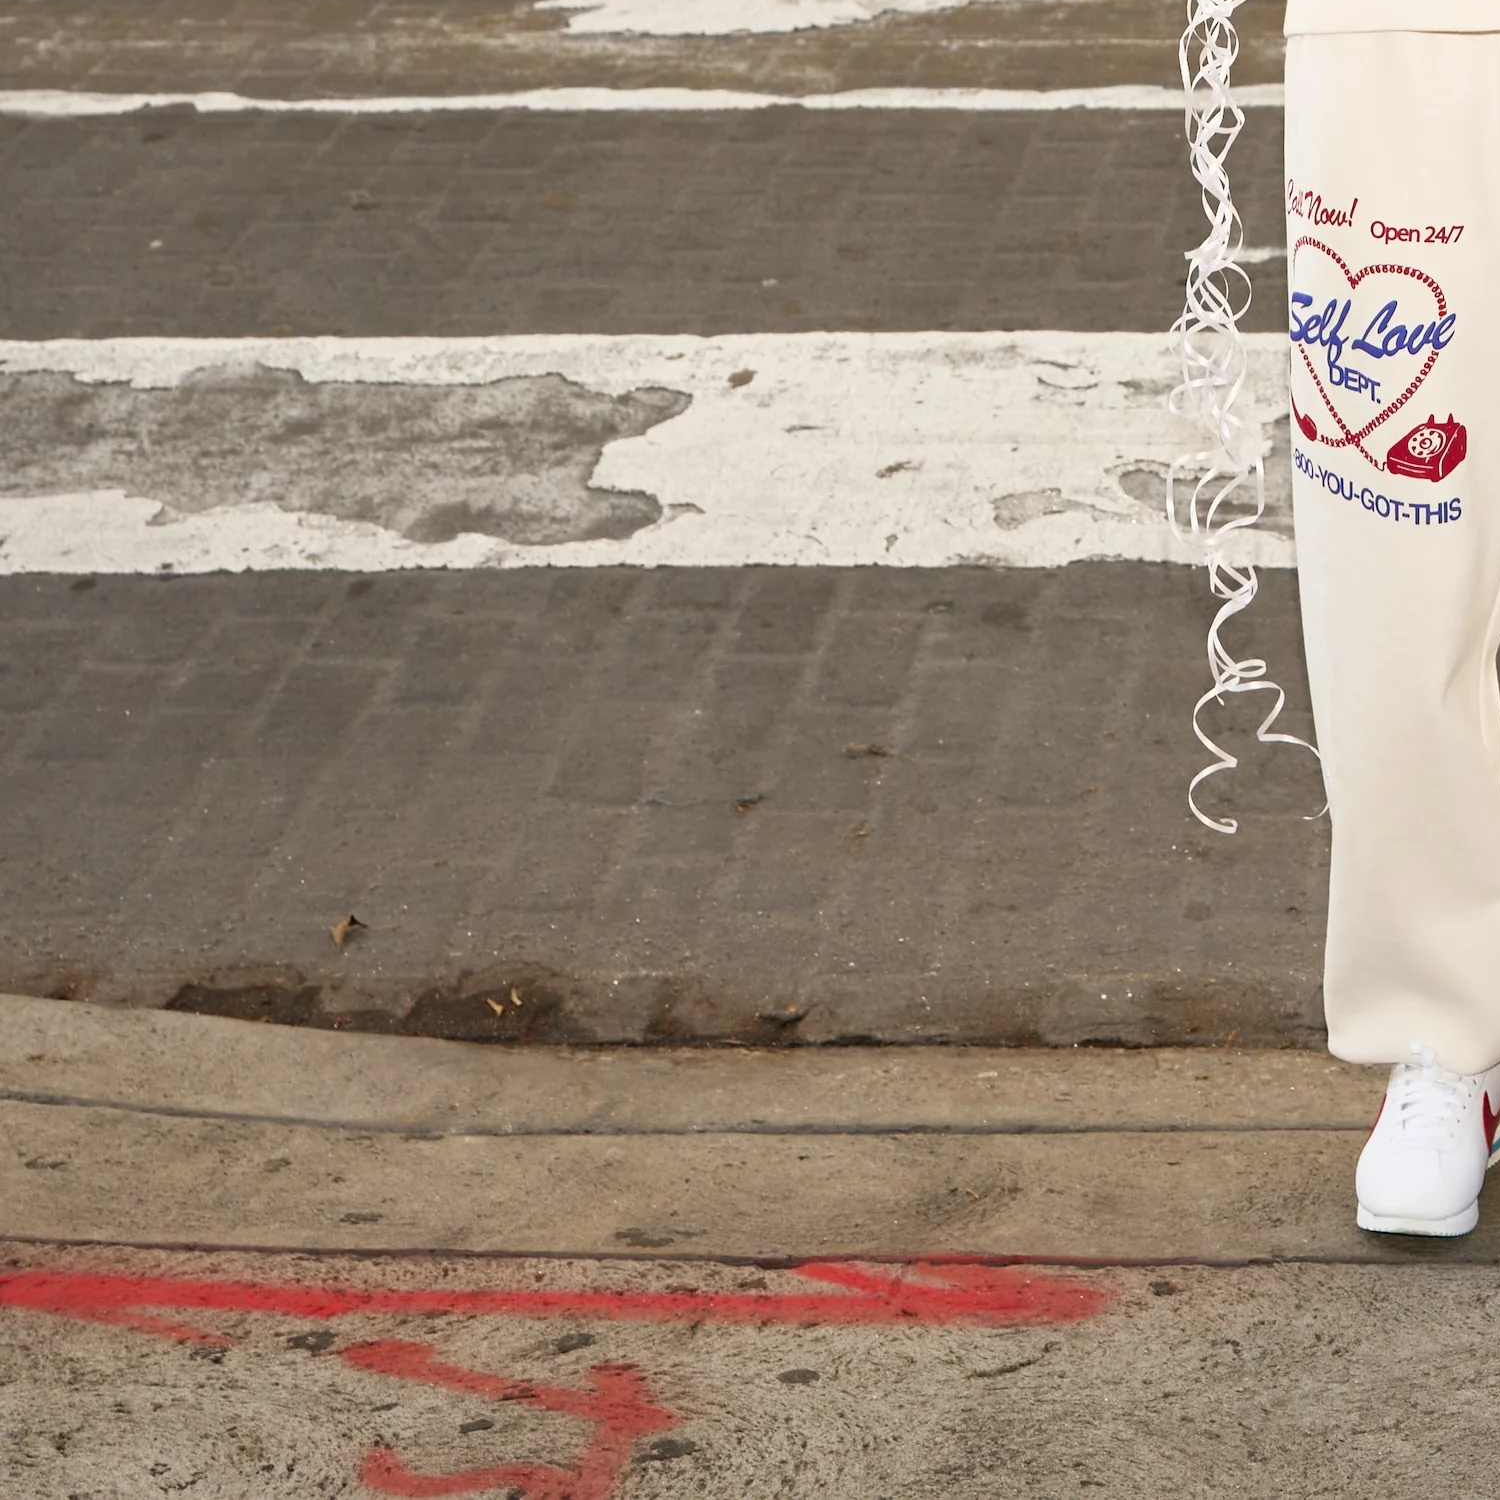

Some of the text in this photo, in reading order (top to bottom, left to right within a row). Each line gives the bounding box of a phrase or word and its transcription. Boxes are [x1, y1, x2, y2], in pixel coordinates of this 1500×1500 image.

[1304, 190, 1359, 228] Now!
[1370, 221, 1465, 245] Open 24/7
[1290, 291, 1457, 367] Self Love
[1329, 363, 1382, 404] DEPT.
